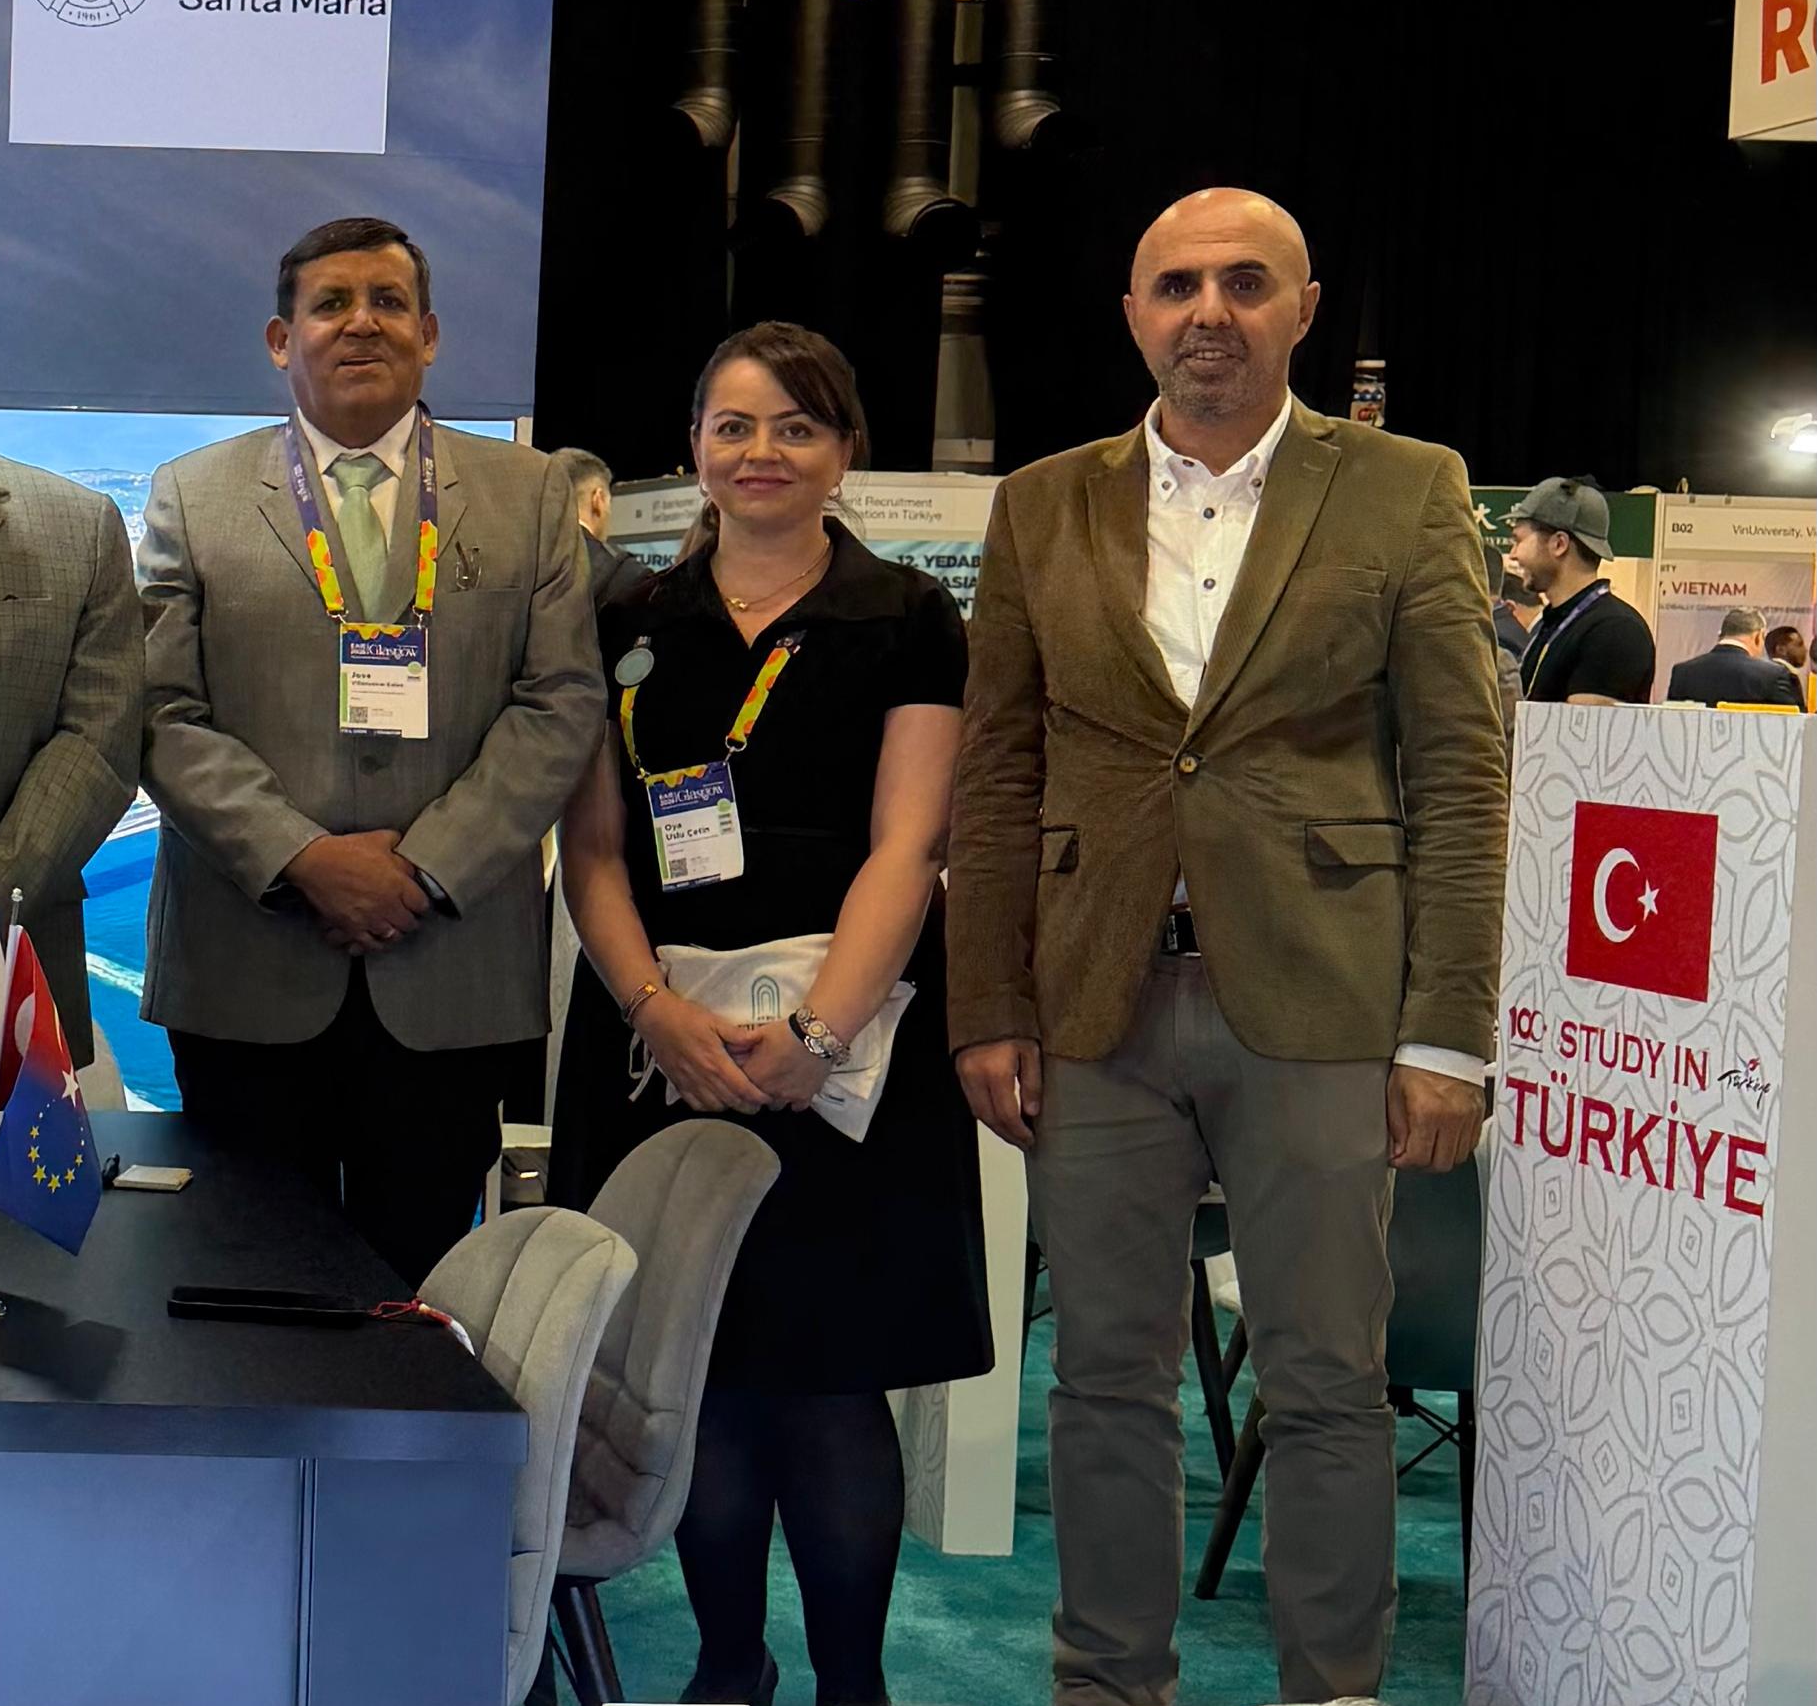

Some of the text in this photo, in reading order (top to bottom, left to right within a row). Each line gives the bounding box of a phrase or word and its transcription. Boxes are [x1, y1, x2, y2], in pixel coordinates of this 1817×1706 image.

[1671, 523, 1694, 533] B02
[1672, 581, 1747, 596] VIETNAM
[1559, 1020, 1666, 1080] STUDY
[1673, 1045, 1710, 1091] IN
[1506, 1069, 1768, 1219] TÜRKİYE
